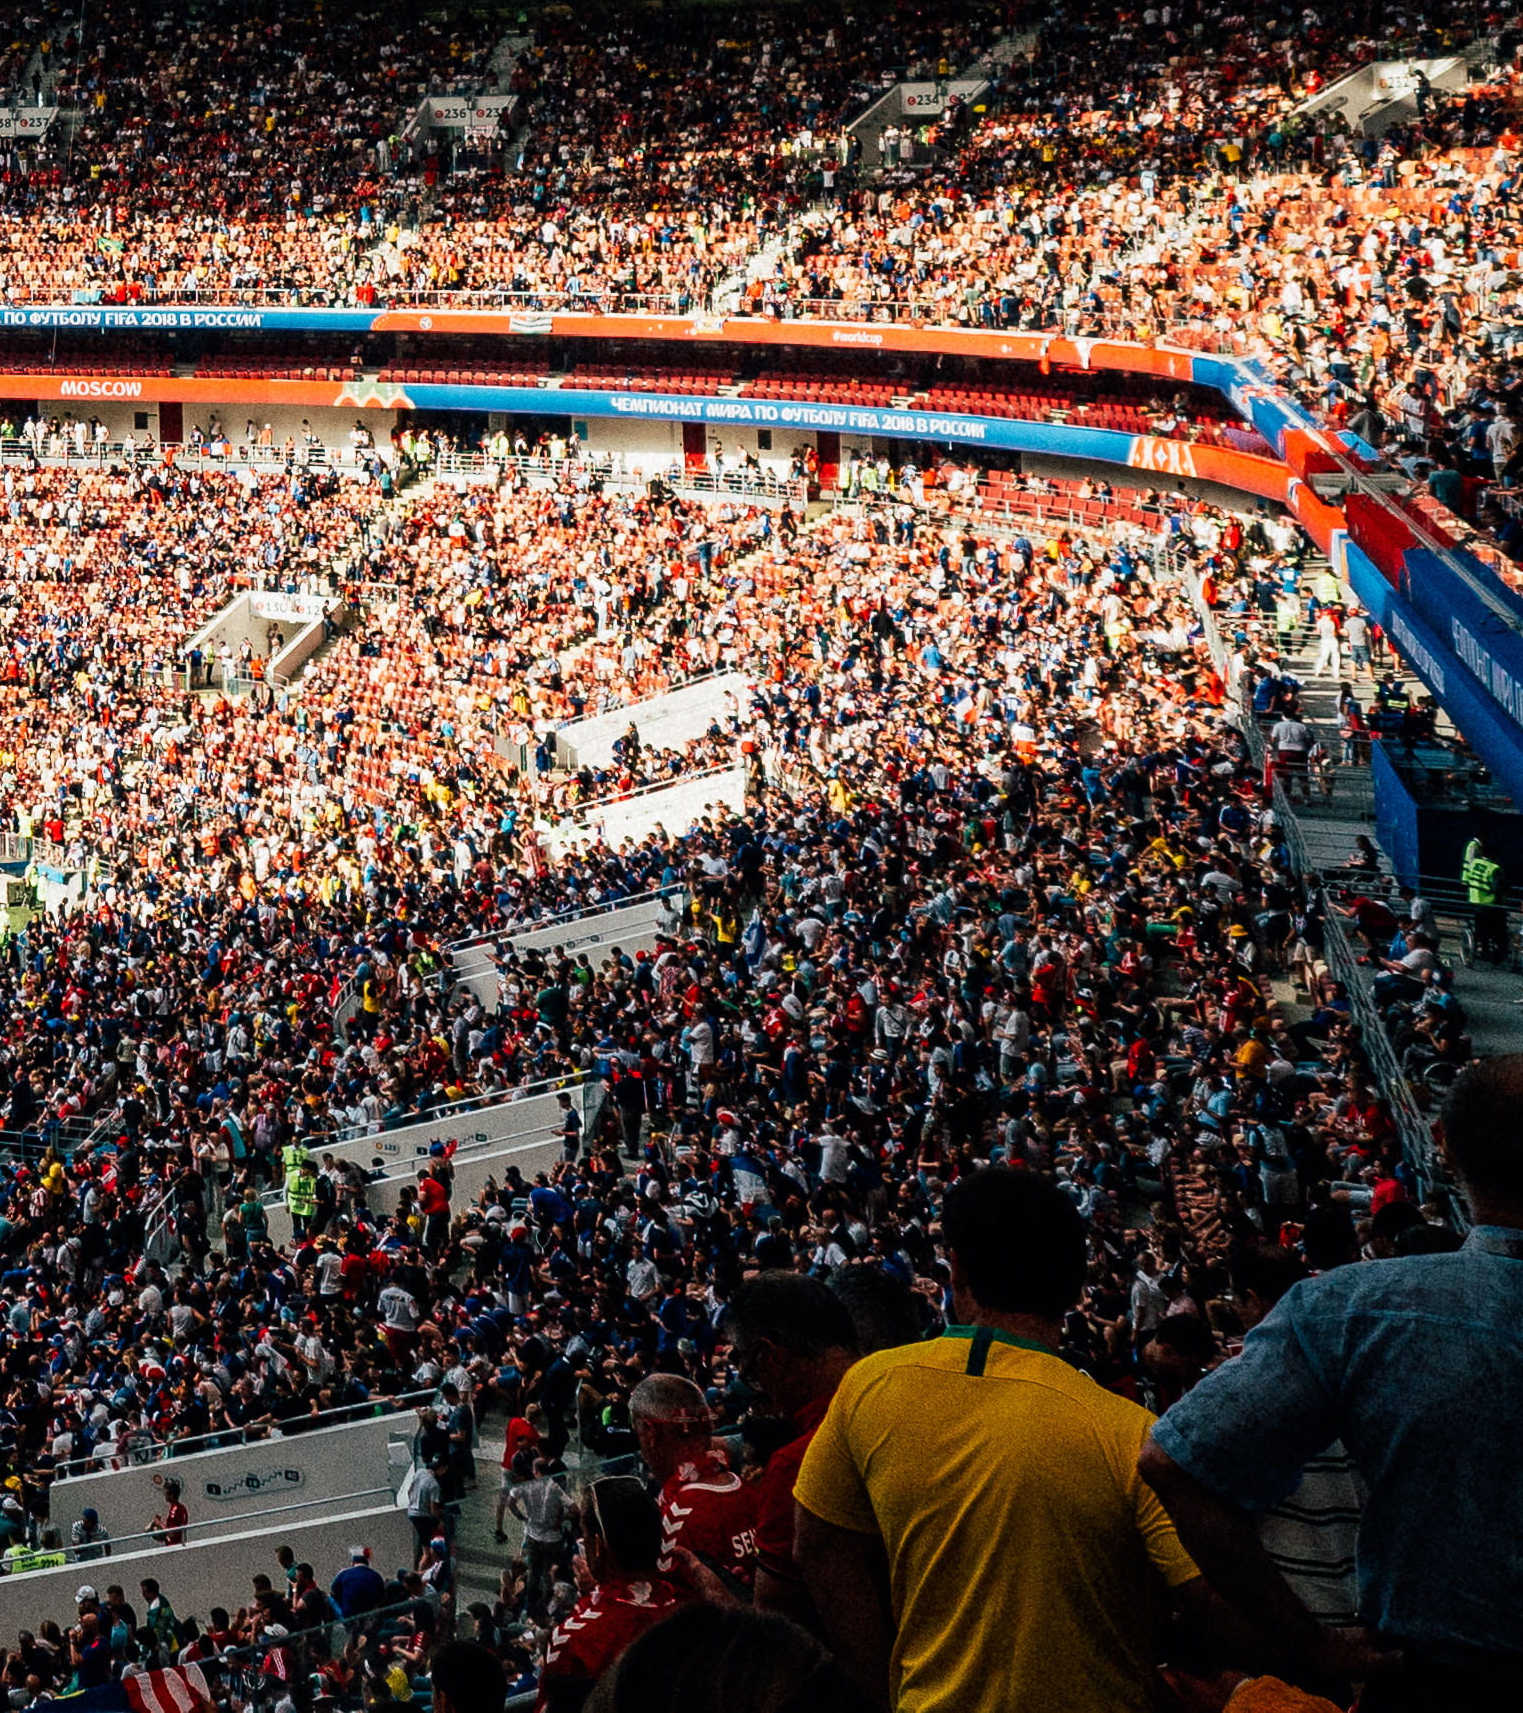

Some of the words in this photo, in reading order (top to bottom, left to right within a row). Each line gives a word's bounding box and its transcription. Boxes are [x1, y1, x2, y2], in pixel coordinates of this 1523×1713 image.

[917, 95, 939, 105] 234
[444, 109, 466, 119] 236
[29, 118, 49, 128] 237
[5, 312, 26, 325] ПО
[30, 312, 101, 327] ФУТБОЛУ
[106, 313, 138, 326] FIFA
[142, 313, 177, 326] 2018
[180, 313, 191, 326] В
[195, 313, 262, 327] РОССИИ
[832, 331, 883, 346] #worldcup
[61, 381, 142, 397] MOSCOW
[611, 397, 703, 416] ЧЕМПИОНАТ
[707, 402, 753, 419] МИРА
[755, 404, 777, 420] ПО
[781, 406, 846, 426] ФУТБОЛУ
[849, 411, 879, 429] FIFA
[882, 414, 914, 432] 2018
[917, 417, 927, 433] В
[931, 419, 986, 440] РОССИИ
